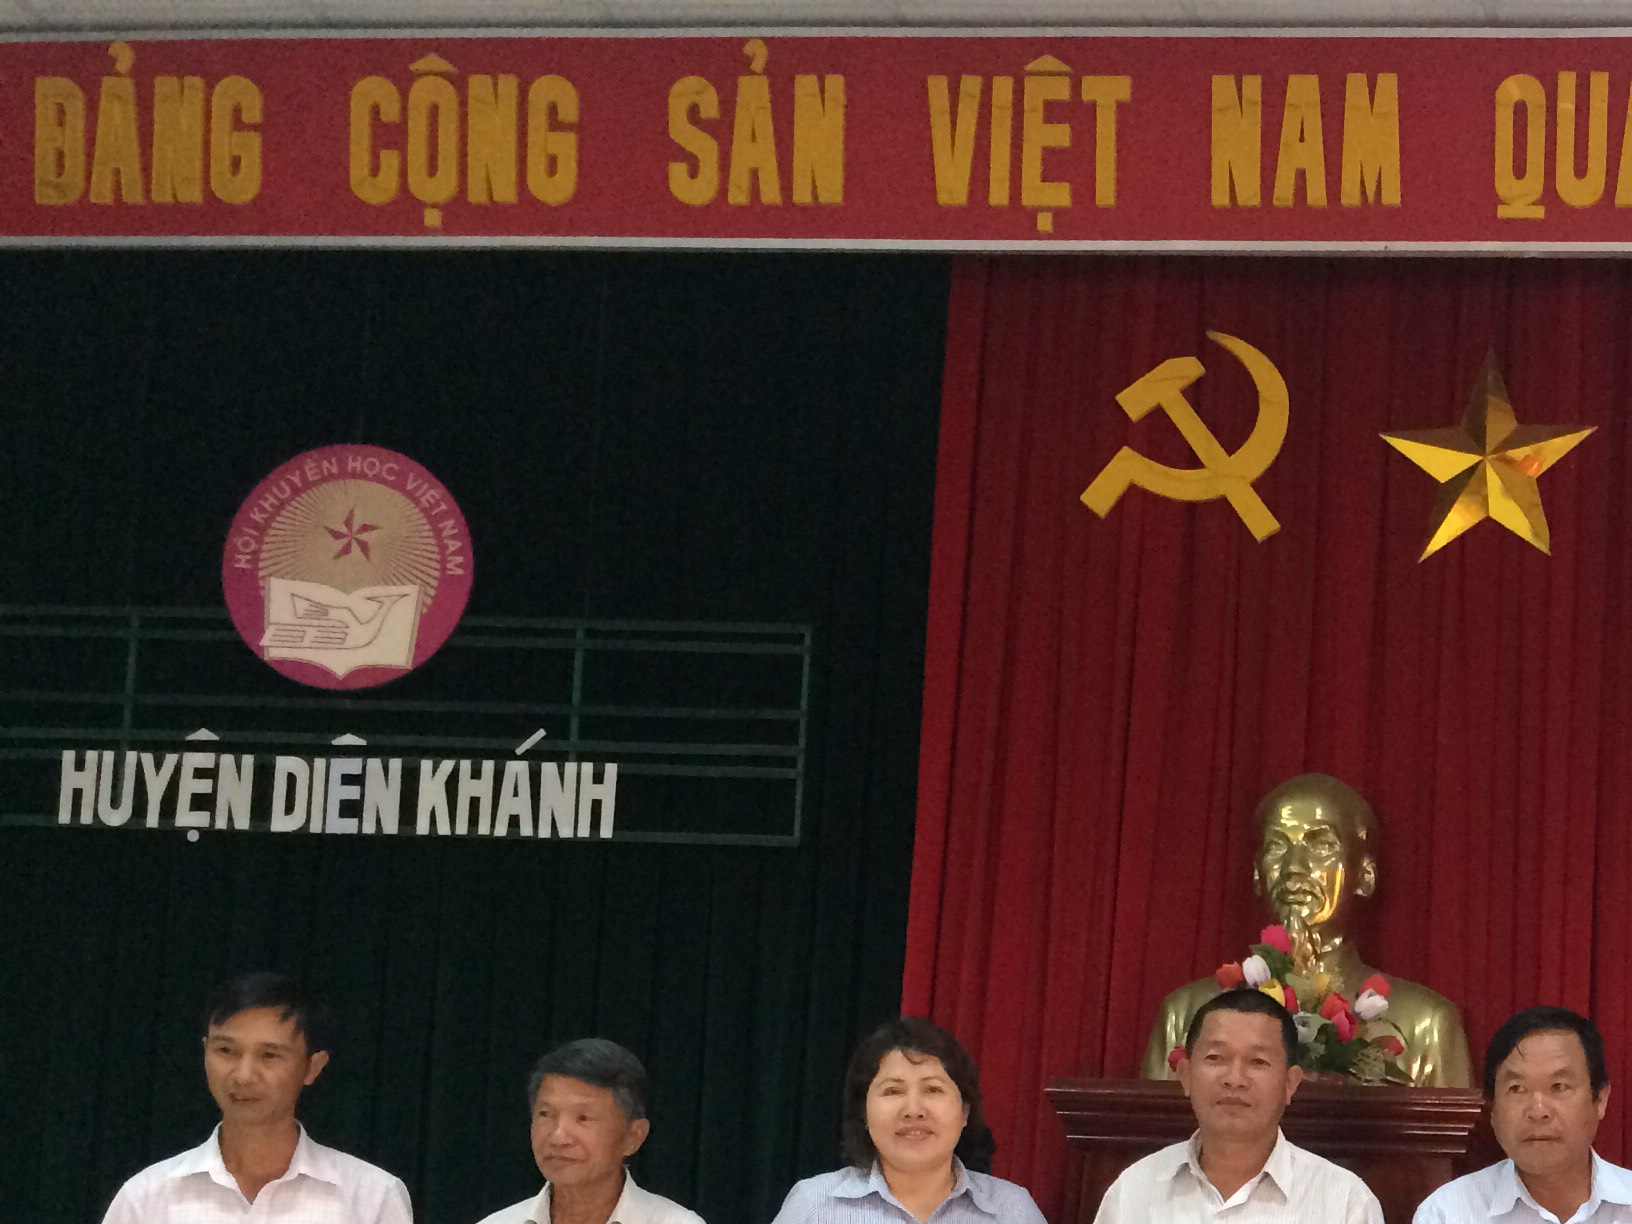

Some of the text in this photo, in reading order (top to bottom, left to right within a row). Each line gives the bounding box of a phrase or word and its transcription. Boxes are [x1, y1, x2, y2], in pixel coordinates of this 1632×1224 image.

[34, 41, 262, 204] ĐẢNG
[350, 56, 578, 227] CỘNG
[668, 40, 845, 204] SẢN
[928, 56, 1130, 231] VIỆT
[1212, 73, 1400, 208] NAM
[347, 456, 400, 481] HỌC
[438, 520, 464, 575] NAM
[59, 728, 617, 841] HUYỆN DIÊN KHÁNH
